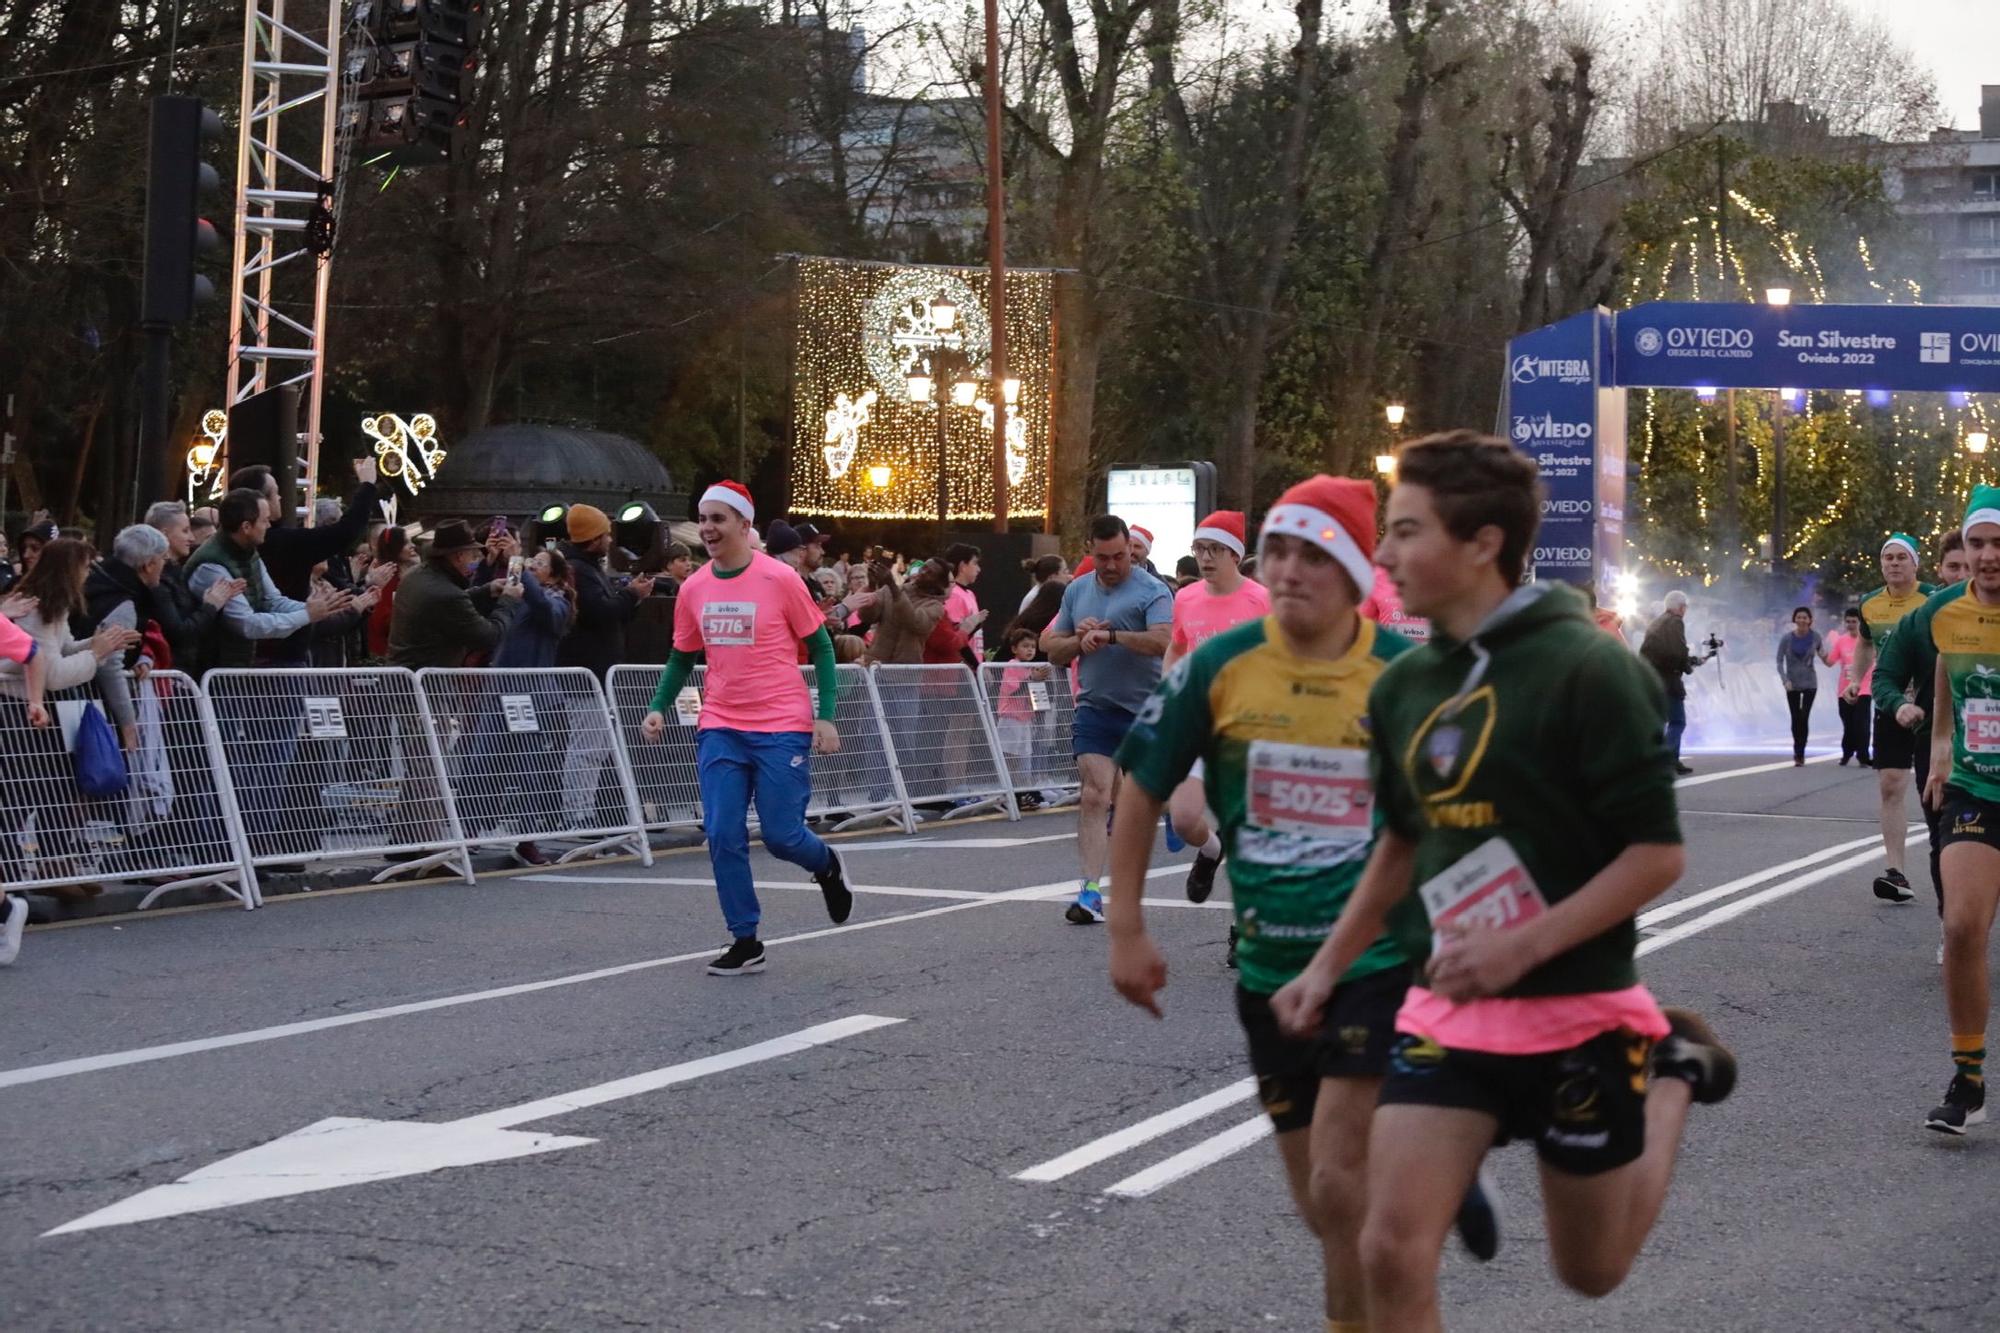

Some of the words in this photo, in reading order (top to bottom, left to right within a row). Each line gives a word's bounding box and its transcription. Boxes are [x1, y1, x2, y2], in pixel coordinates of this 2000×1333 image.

[1667, 327, 1753, 348] OVIEDO
[1777, 330, 1813, 347] San
[1817, 330, 1896, 349] Silvestre
[1700, 349, 1716, 358] DEL
[1717, 349, 1753, 358] CAMINO
[1798, 352, 1840, 363] Oviedo
[1842, 353, 1875, 364] 2022
[1538, 359, 1589, 377] INTEGRA
[1515, 413, 1592, 438] OVIEDO
[1539, 453, 1592, 466] Silvestre
[1555, 468, 1578, 476] 2022
[1540, 499, 1592, 513] OVIEDO
[1533, 547, 1592, 561] OVIEDO
[709, 618, 744, 634] 5776
[1269, 779, 1352, 817] 5025
